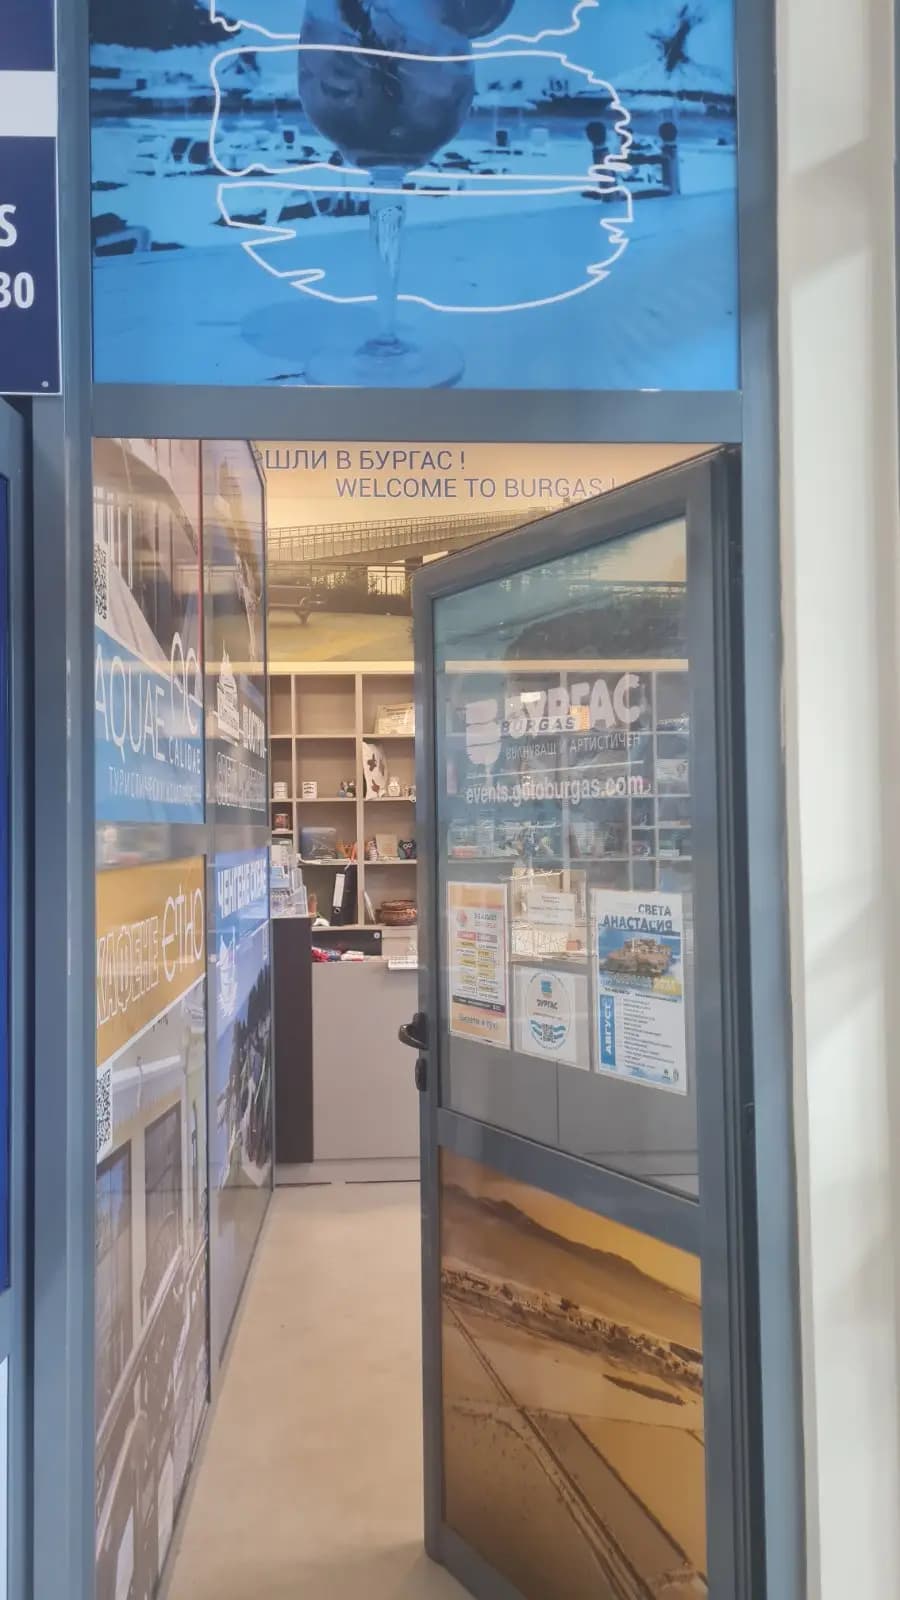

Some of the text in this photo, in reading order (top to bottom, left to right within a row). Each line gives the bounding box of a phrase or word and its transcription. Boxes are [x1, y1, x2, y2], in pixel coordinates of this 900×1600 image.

[336, 450, 352, 470] В
[359, 449, 452, 471] БУРГАС
[336, 477, 457, 498] WELCOME
[464, 477, 496, 498] TO
[505, 477, 602, 498] BURGAS
[502, 716, 577, 735] BURGAS
[569, 733, 642, 753] АРТИСТИЧЕН
[465, 774, 645, 807] events.gotoburgas.com
[638, 903, 672, 917] СВЕТА
[603, 914, 673, 932] АНАСТАСИЯ
